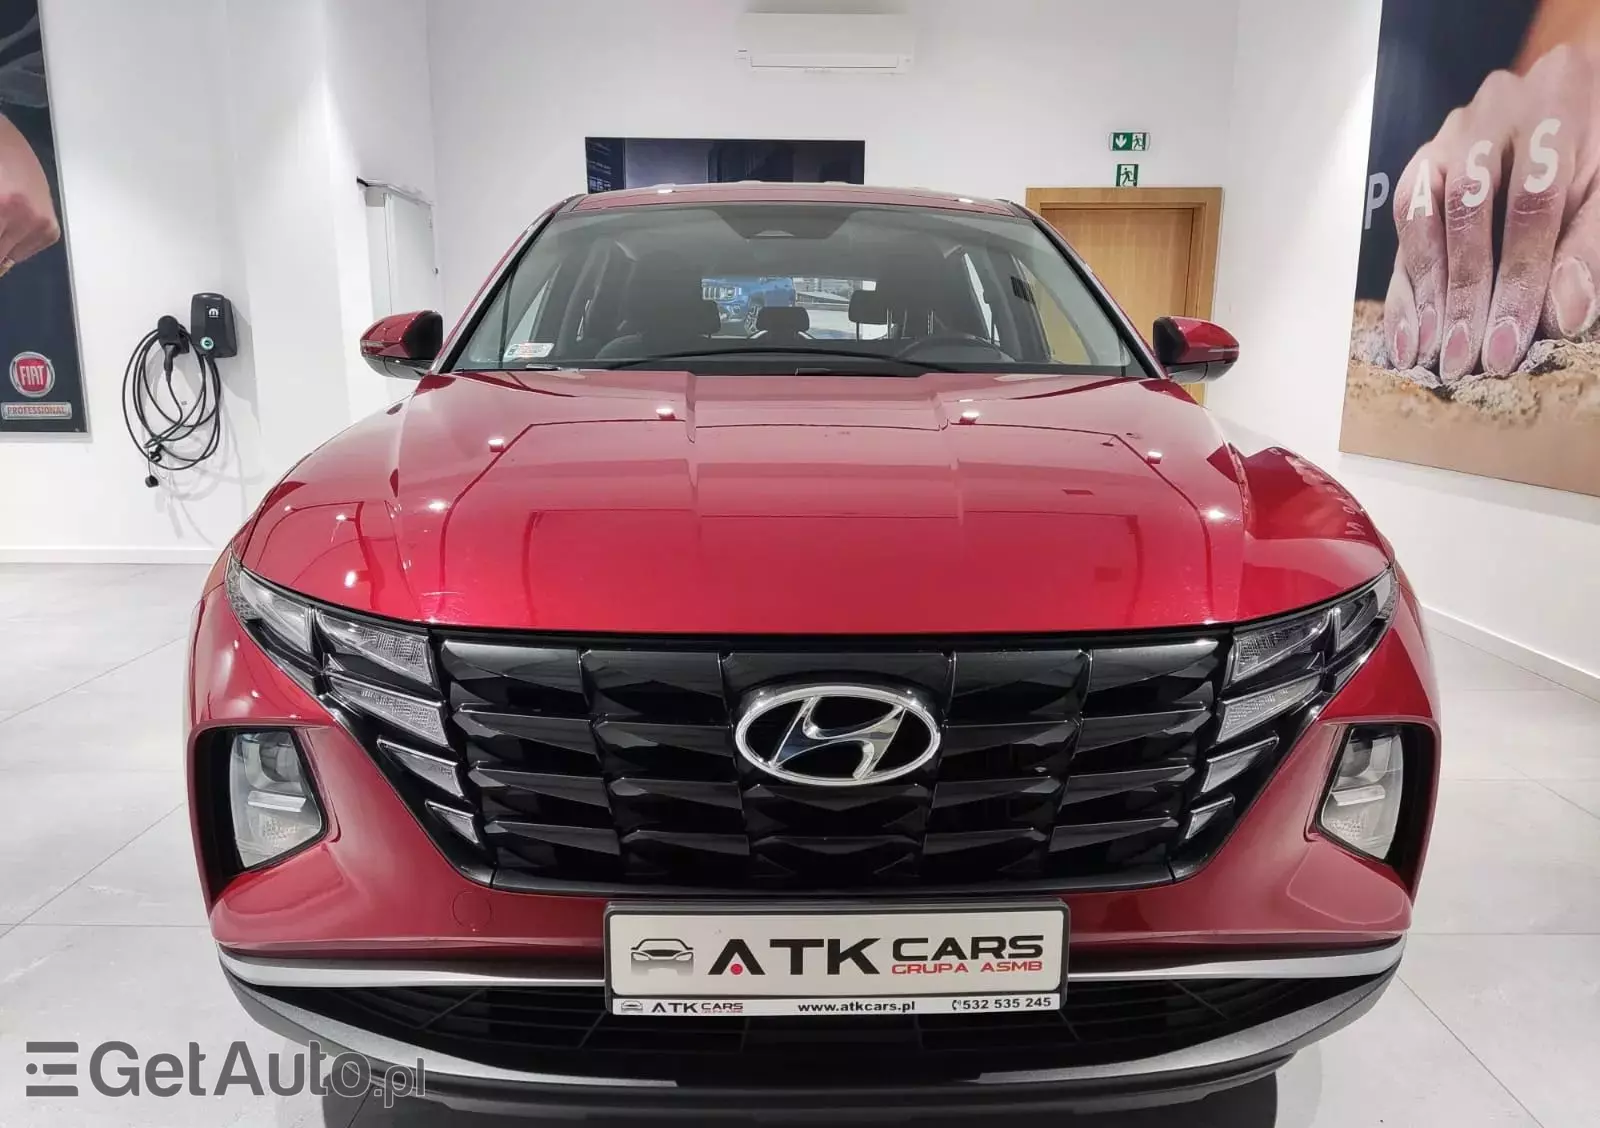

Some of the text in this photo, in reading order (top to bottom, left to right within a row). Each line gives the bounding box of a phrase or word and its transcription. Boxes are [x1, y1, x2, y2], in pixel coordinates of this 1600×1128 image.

[19, 365, 45, 386] FIAT
[7, 406, 66, 415] PROFESSIONAL
[707, 935, 1044, 976] ATK CARS
[891, 960, 1043, 975] GRUPA ASMB
[651, 1002, 744, 1013] ATK CARS
[798, 1000, 915, 1013] www.atkcars.pl
[962, 997, 1052, 1010] 532 535 245
